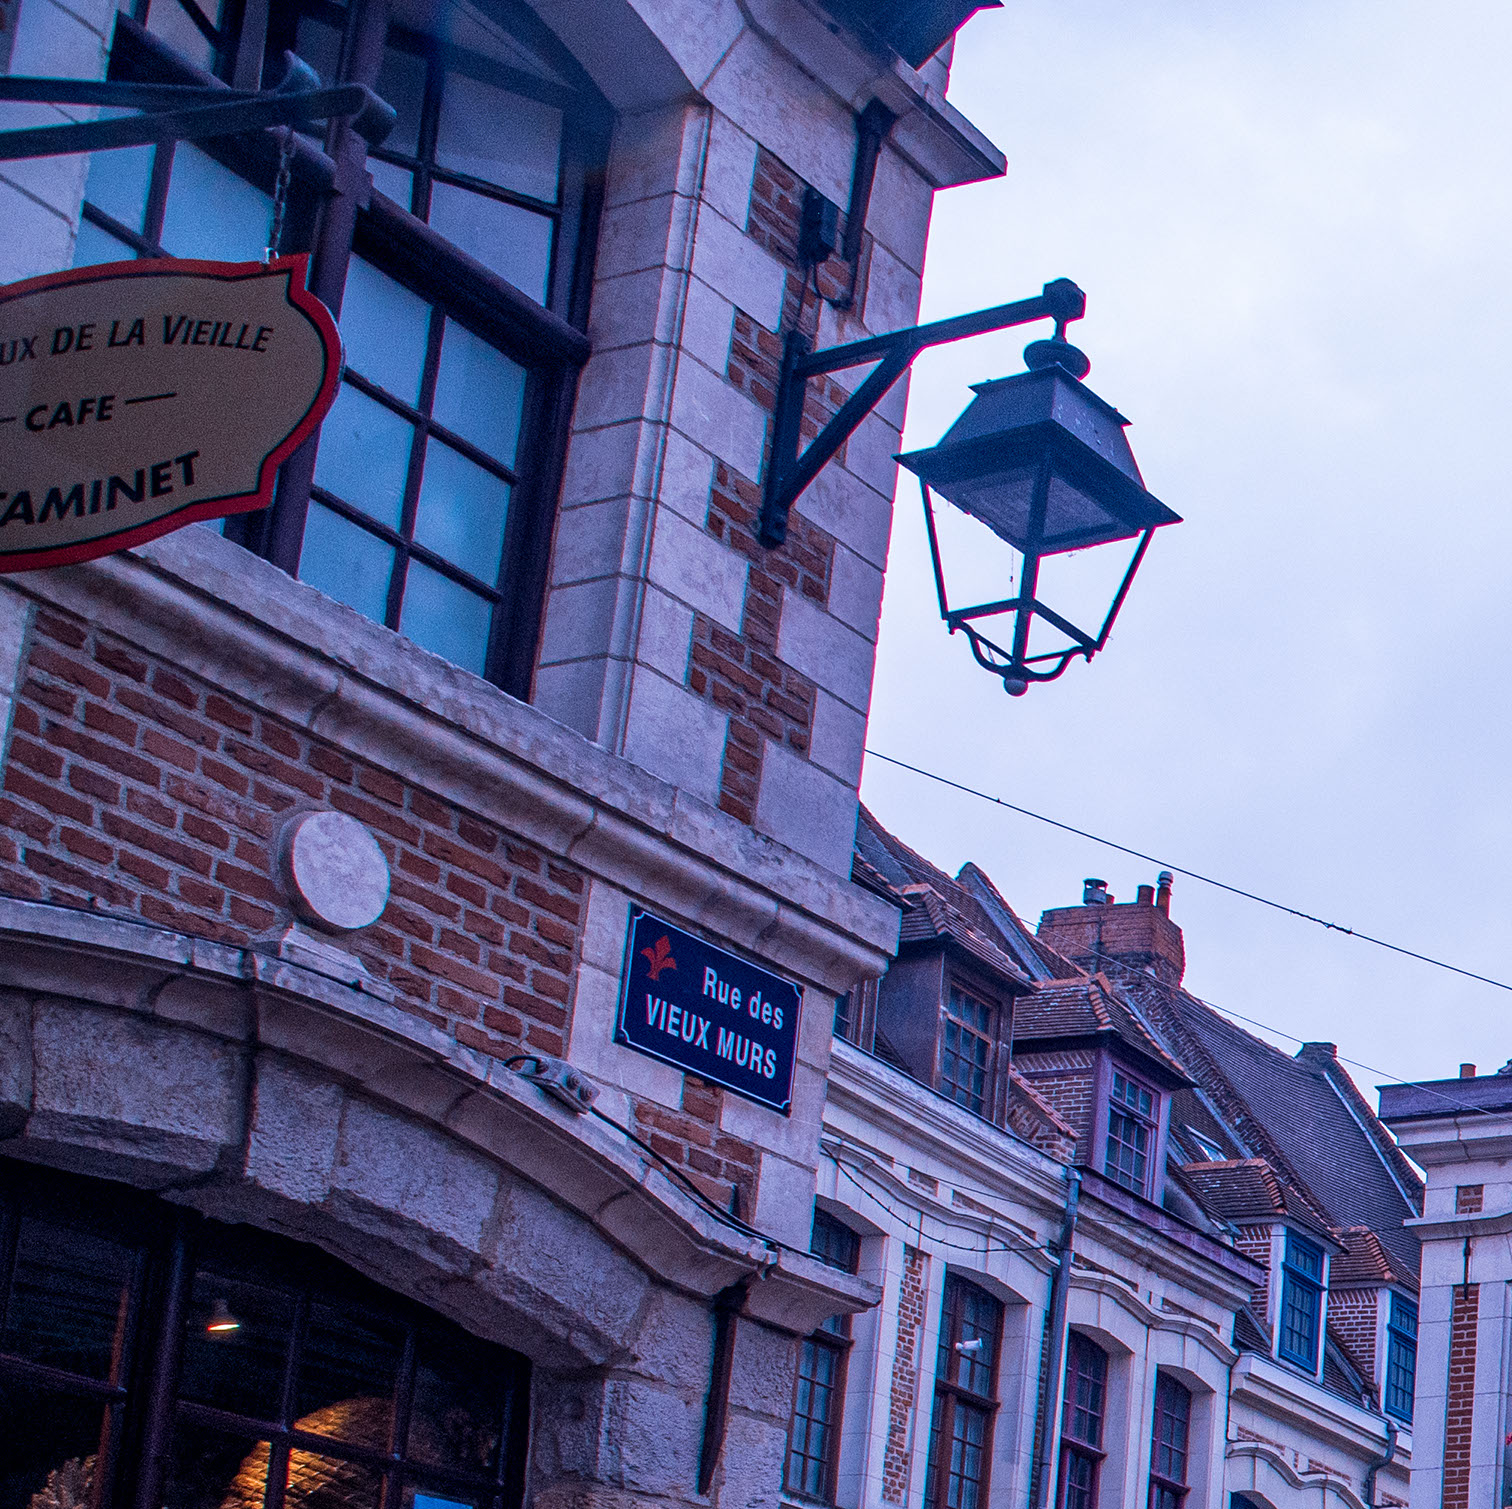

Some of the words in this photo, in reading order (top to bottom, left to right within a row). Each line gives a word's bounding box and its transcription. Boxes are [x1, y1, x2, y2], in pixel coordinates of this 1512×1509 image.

[50, 323, 97, 356] DE
[107, 318, 145, 348] LA
[162, 315, 274, 352] VIEILLE
[24, 395, 116, 432] CAFE
[703, 966, 742, 1010] Rue
[749, 991, 784, 1030] des
[646, 994, 710, 1050] VIEUX
[716, 1026, 777, 1079] MURS
